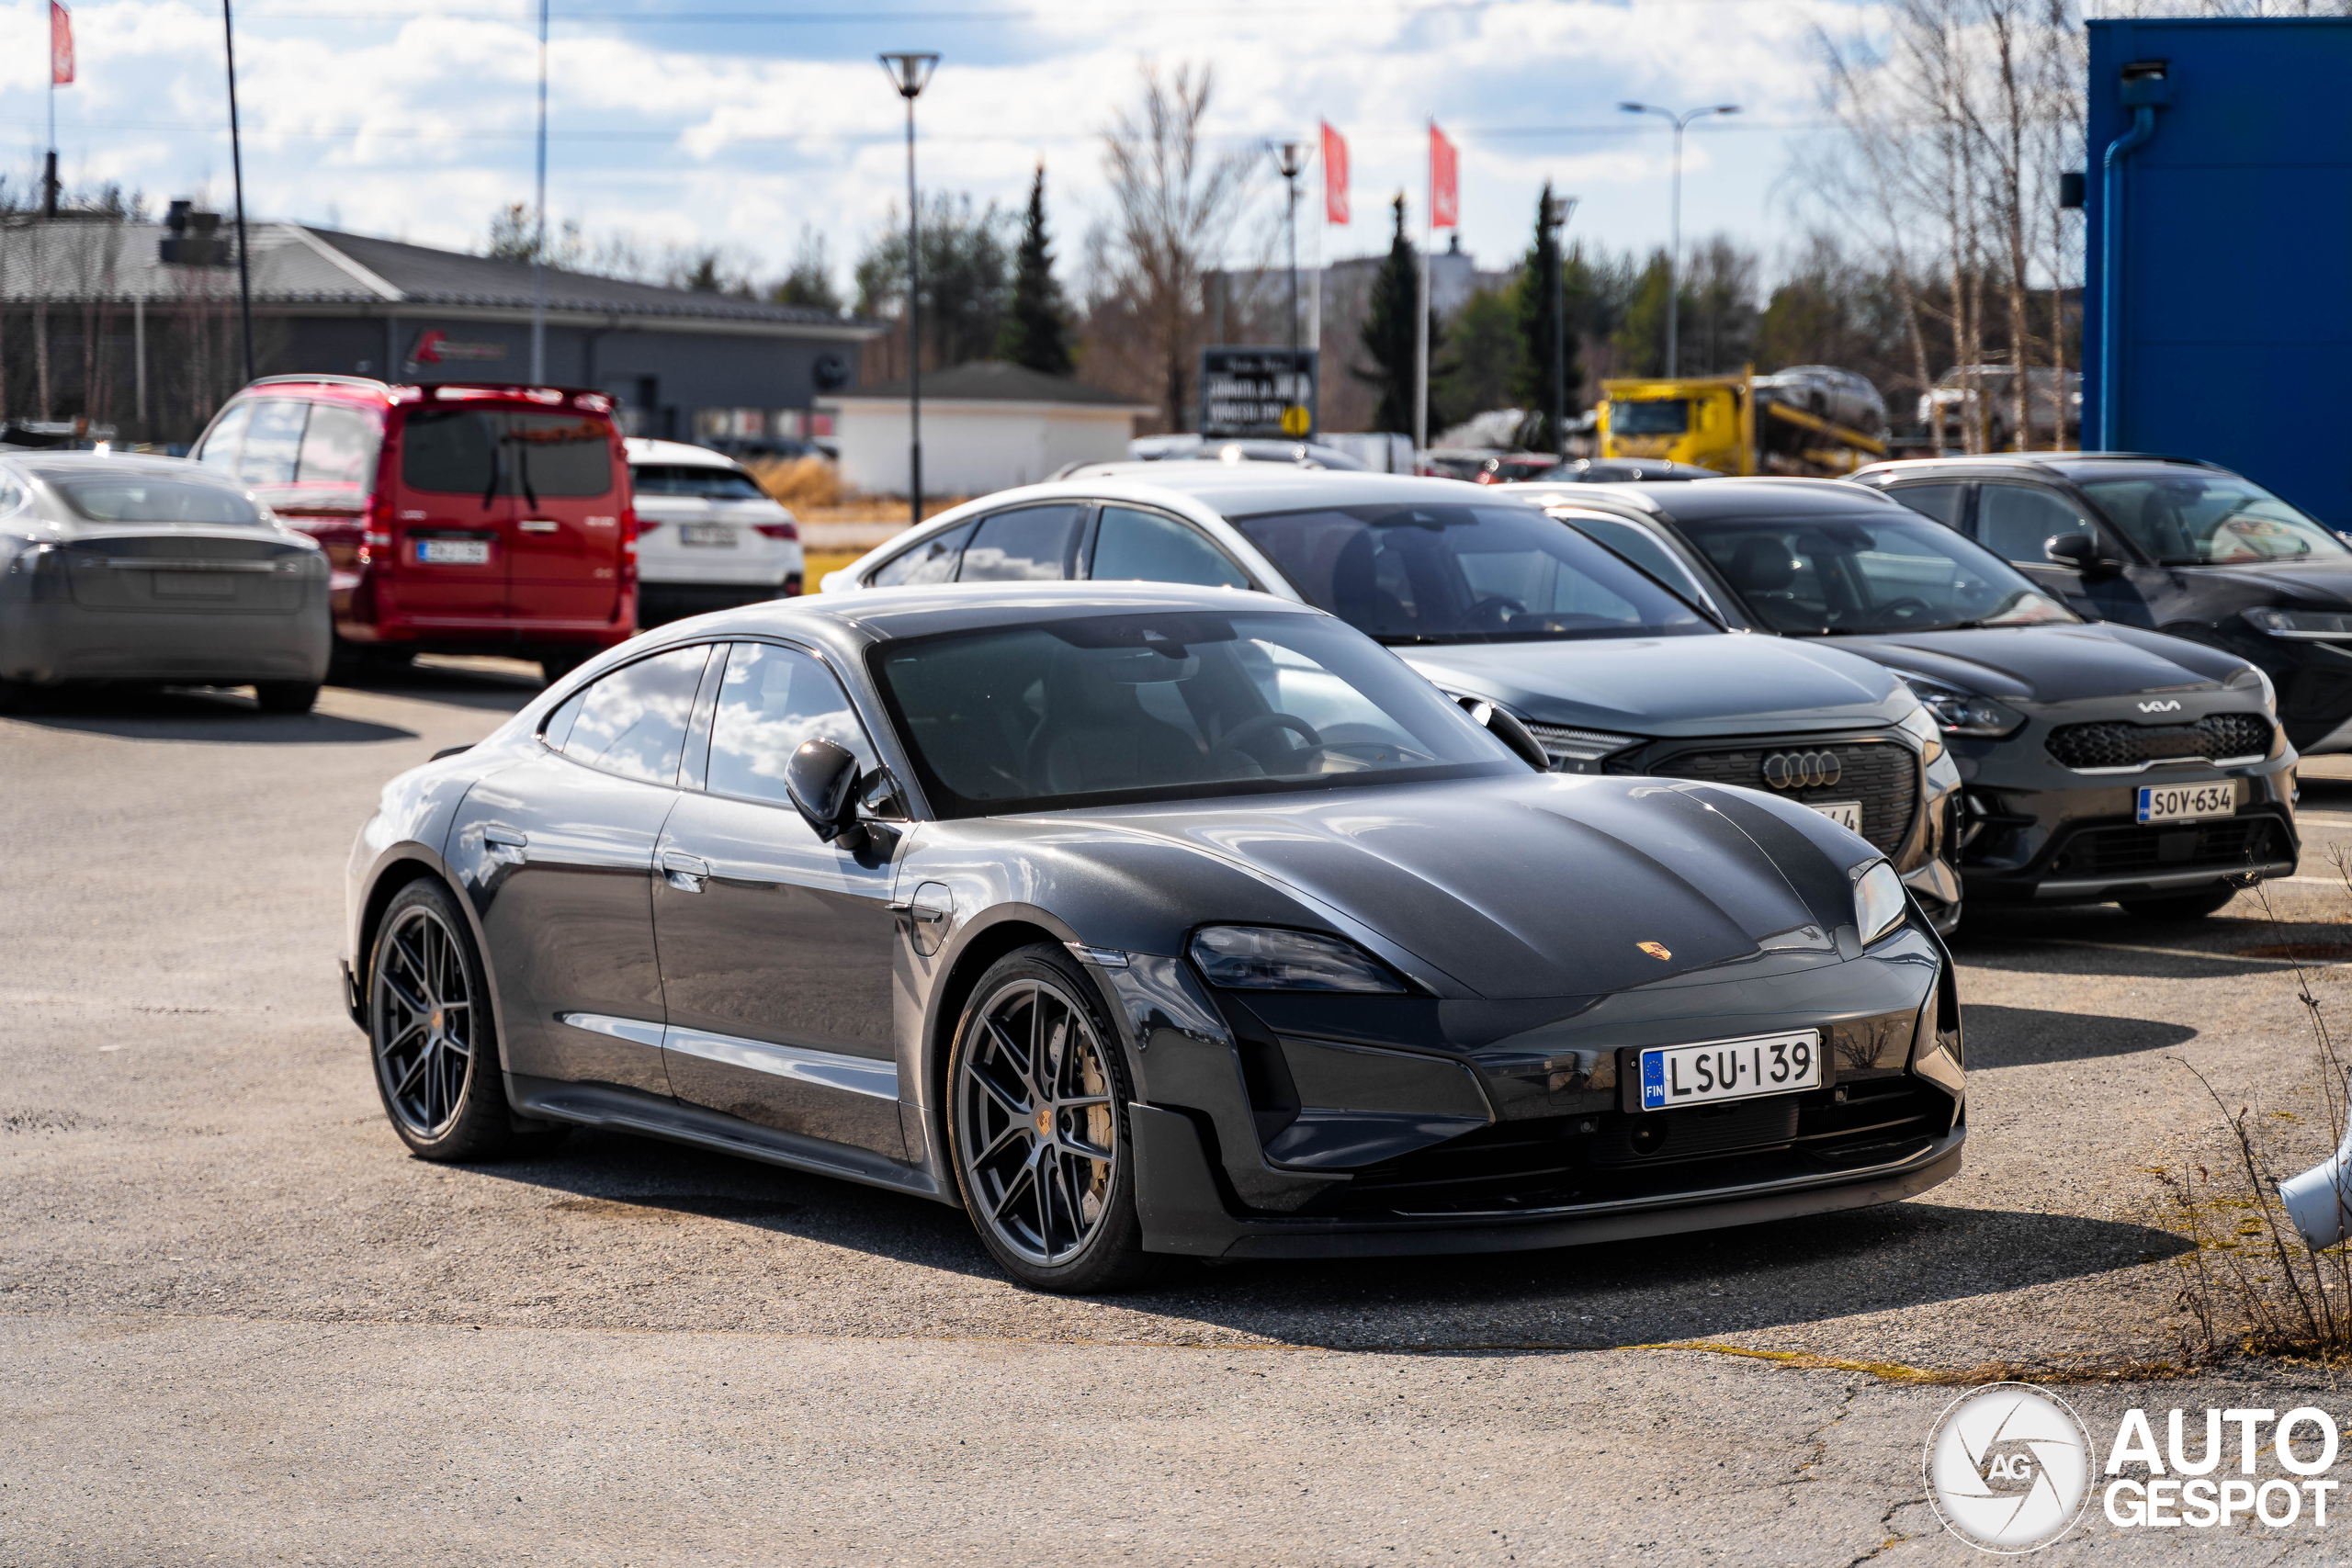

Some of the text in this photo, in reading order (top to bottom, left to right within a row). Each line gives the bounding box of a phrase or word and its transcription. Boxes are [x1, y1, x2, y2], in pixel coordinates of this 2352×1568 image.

[2138, 700, 2181, 713] KIA
[1671, 1042, 1811, 1097] LSU-139
[1646, 1085, 1663, 1098] FIN
